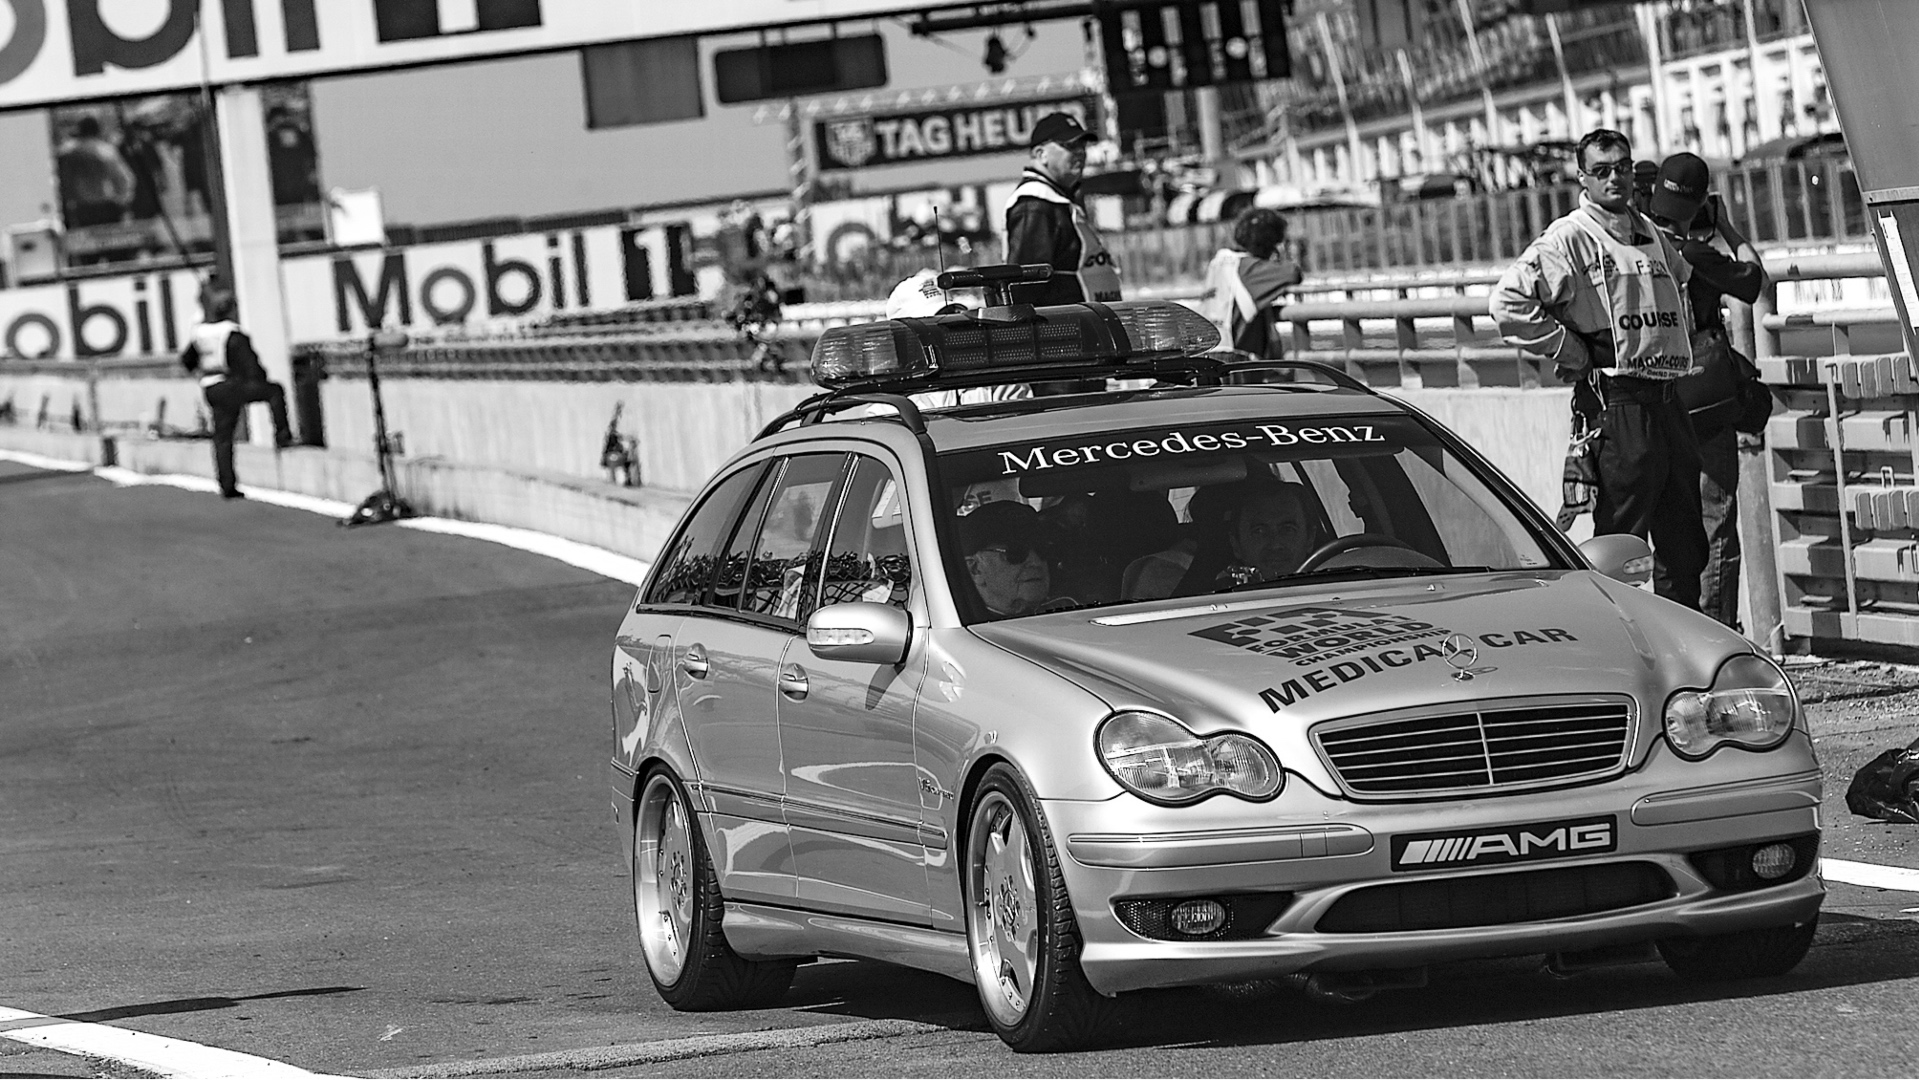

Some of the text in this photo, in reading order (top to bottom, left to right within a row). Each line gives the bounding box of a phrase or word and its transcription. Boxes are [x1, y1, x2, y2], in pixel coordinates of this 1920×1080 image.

[873, 115, 950, 158] TAG
[334, 233, 588, 331] Mobil
[998, 425, 1384, 474] Mercedes-Benz
[1246, 618, 1396, 653] FORMULA
[1266, 622, 1433, 659] WORLD
[1295, 629, 1451, 666] CHAMPIONSHIP
[1257, 628, 1578, 714] MEDICAL CAR
[1466, 823, 1611, 860] AMG
